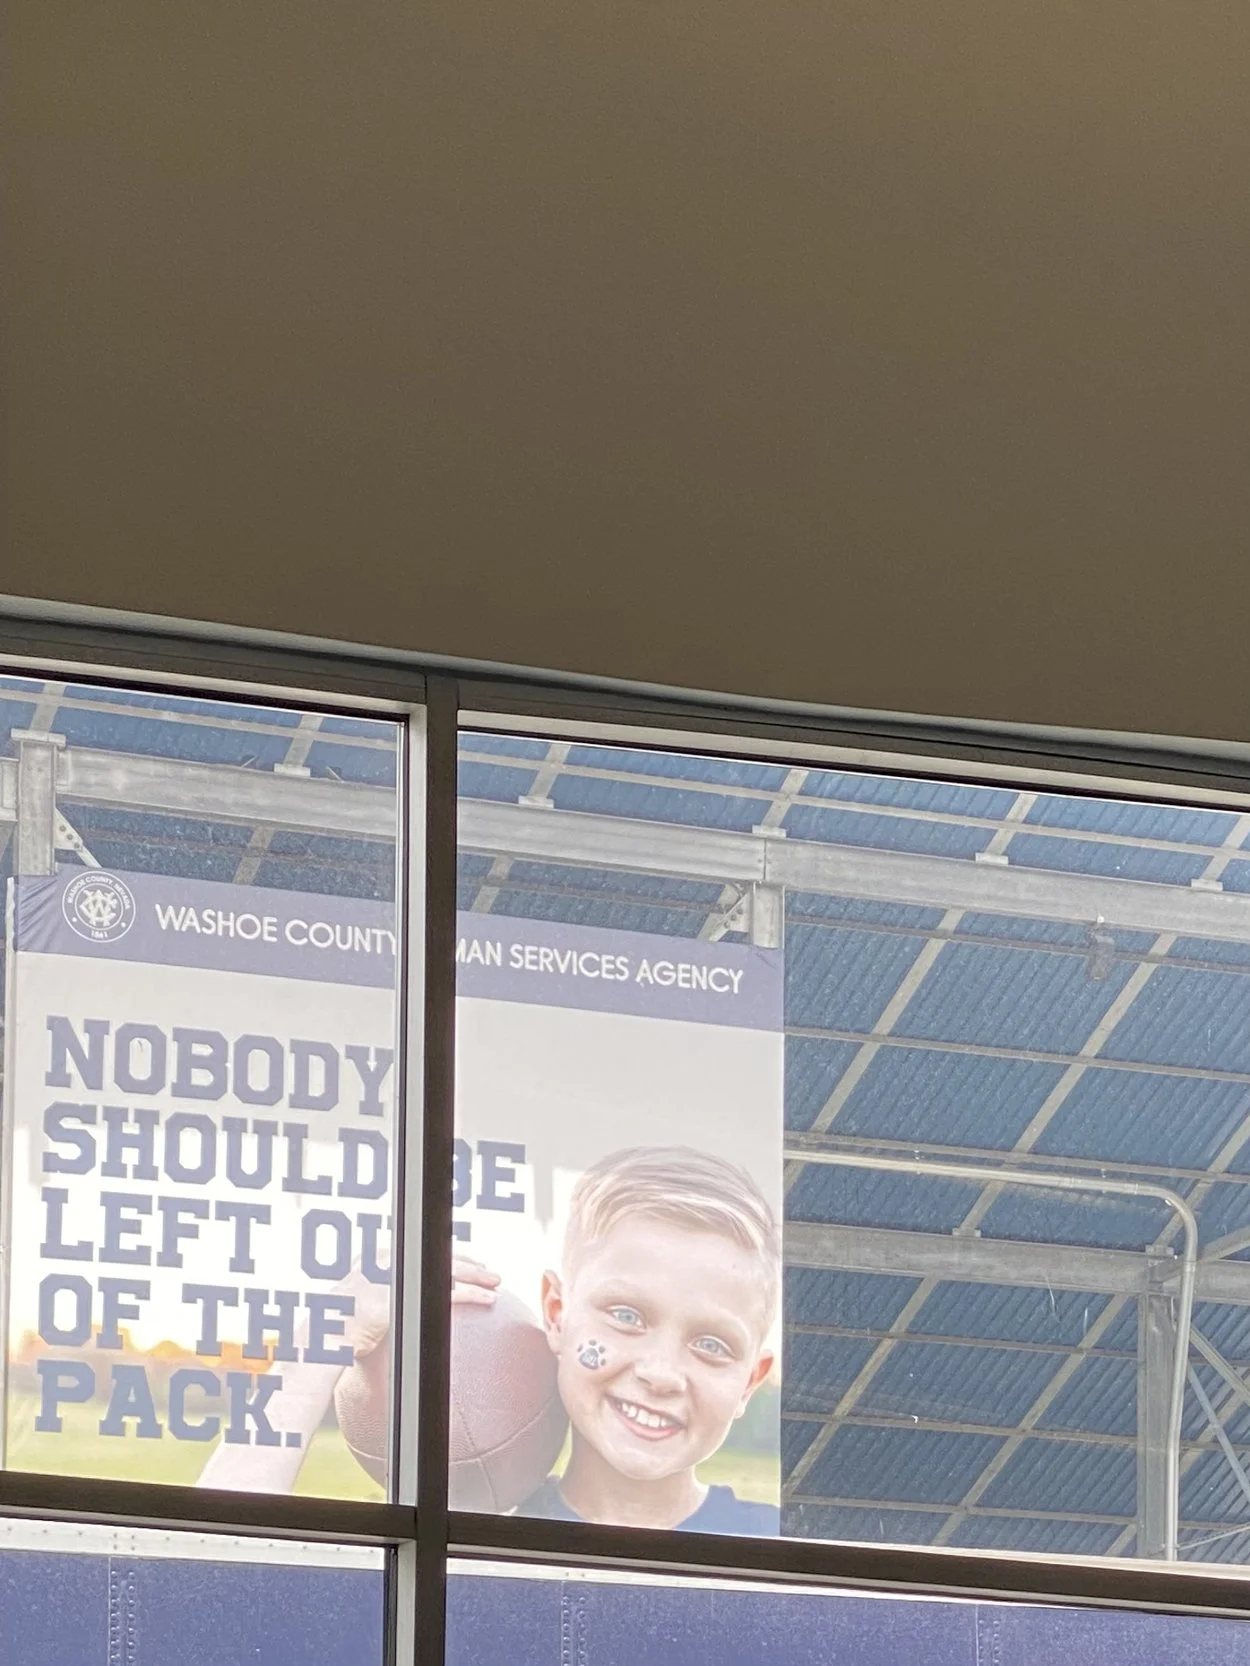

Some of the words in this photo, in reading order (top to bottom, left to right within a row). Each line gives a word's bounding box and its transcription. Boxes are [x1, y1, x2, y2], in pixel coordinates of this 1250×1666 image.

[154, 903, 278, 943] WASHOE
[285, 919, 396, 955] COUNTY
[509, 943, 630, 981] SERVICES
[635, 959, 744, 994] AGENCY
[44, 1014, 394, 1118] NOBODY
[42, 1101, 389, 1200] SHOULD
[40, 1187, 271, 1274] LEFT
[38, 1273, 150, 1350] OF
[182, 1283, 355, 1366] THE
[35, 1360, 301, 1448] PACK.
